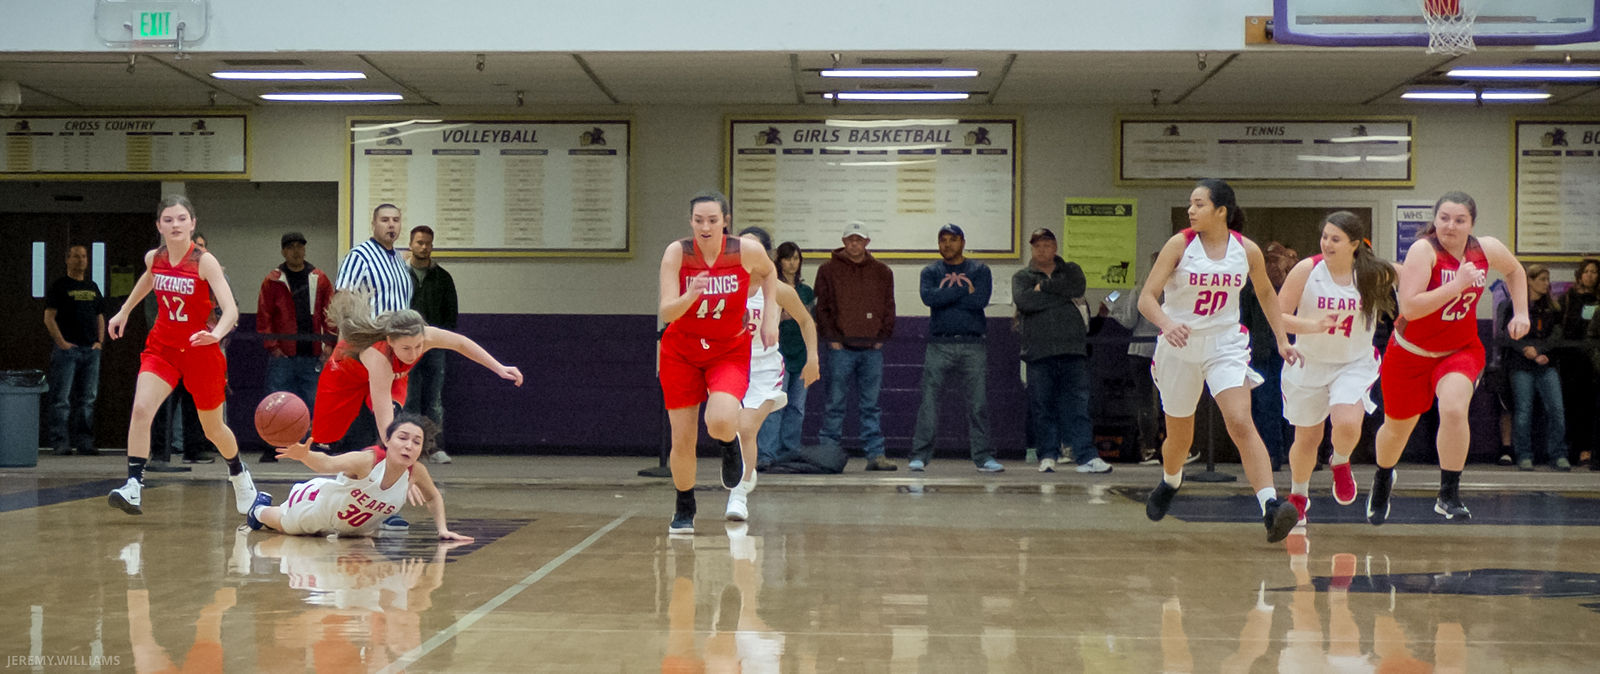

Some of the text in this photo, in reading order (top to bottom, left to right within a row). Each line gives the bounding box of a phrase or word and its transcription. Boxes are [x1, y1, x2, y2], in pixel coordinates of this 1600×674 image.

[141, 12, 171, 36] EXIT
[64, 120, 156, 131] CROSS COUNTRY
[442, 129, 538, 143] VOLLEYBALL
[793, 129, 953, 143] GIRLS BASKETBALL
[1245, 126, 1285, 136] TENNIS
[152, 273, 195, 295] IKINGS
[686, 274, 739, 295] VINGS
[1189, 272, 1242, 287] BEARS
[162, 295, 189, 322] 12
[696, 299, 726, 319] 44
[1193, 290, 1228, 316] 20
[1441, 292, 1477, 321] 23
[350, 488, 396, 516] BEARS
[337, 504, 373, 528] 30
